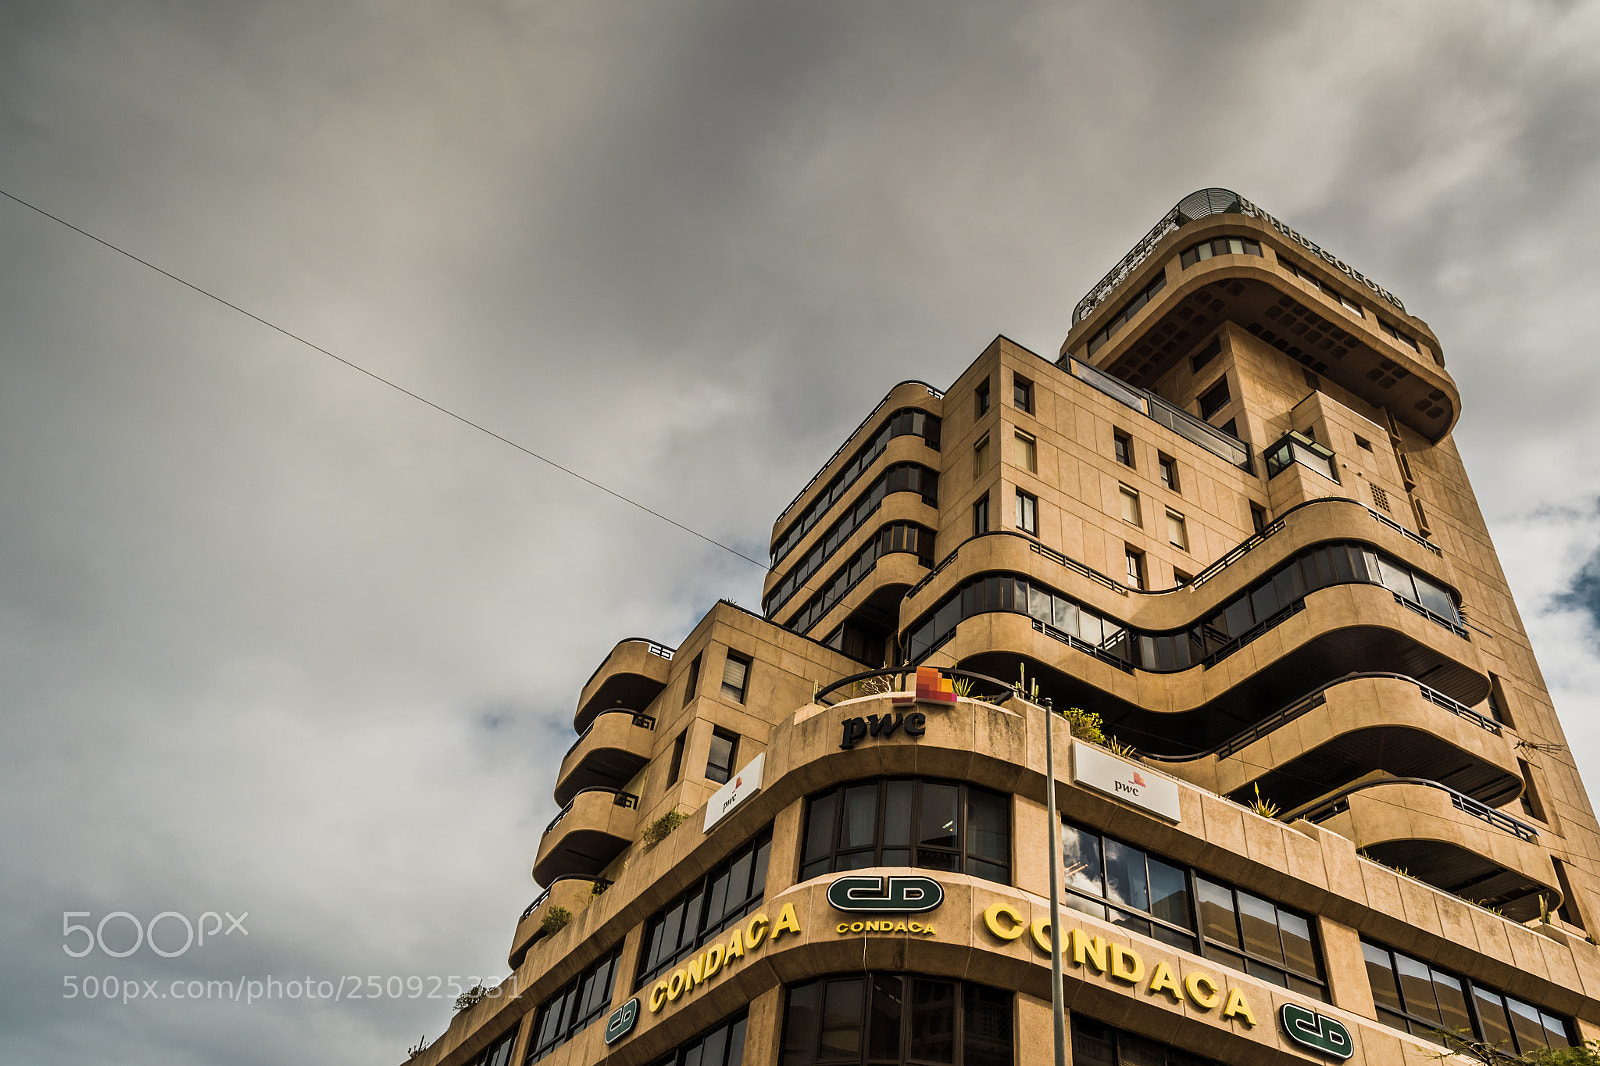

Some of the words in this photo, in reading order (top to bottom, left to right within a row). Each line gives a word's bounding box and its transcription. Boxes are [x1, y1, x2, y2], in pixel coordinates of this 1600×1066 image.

[1239, 195, 1313, 250] UNITED
[1319, 247, 1404, 310] COLORS
[838, 712, 926, 750] pwc
[722, 793, 738, 813] pwc
[1114, 780, 1139, 797] pwc
[835, 919, 936, 936] CONDACA
[649, 902, 801, 1014] CONDACA
[983, 902, 1257, 1027] CONDACA
